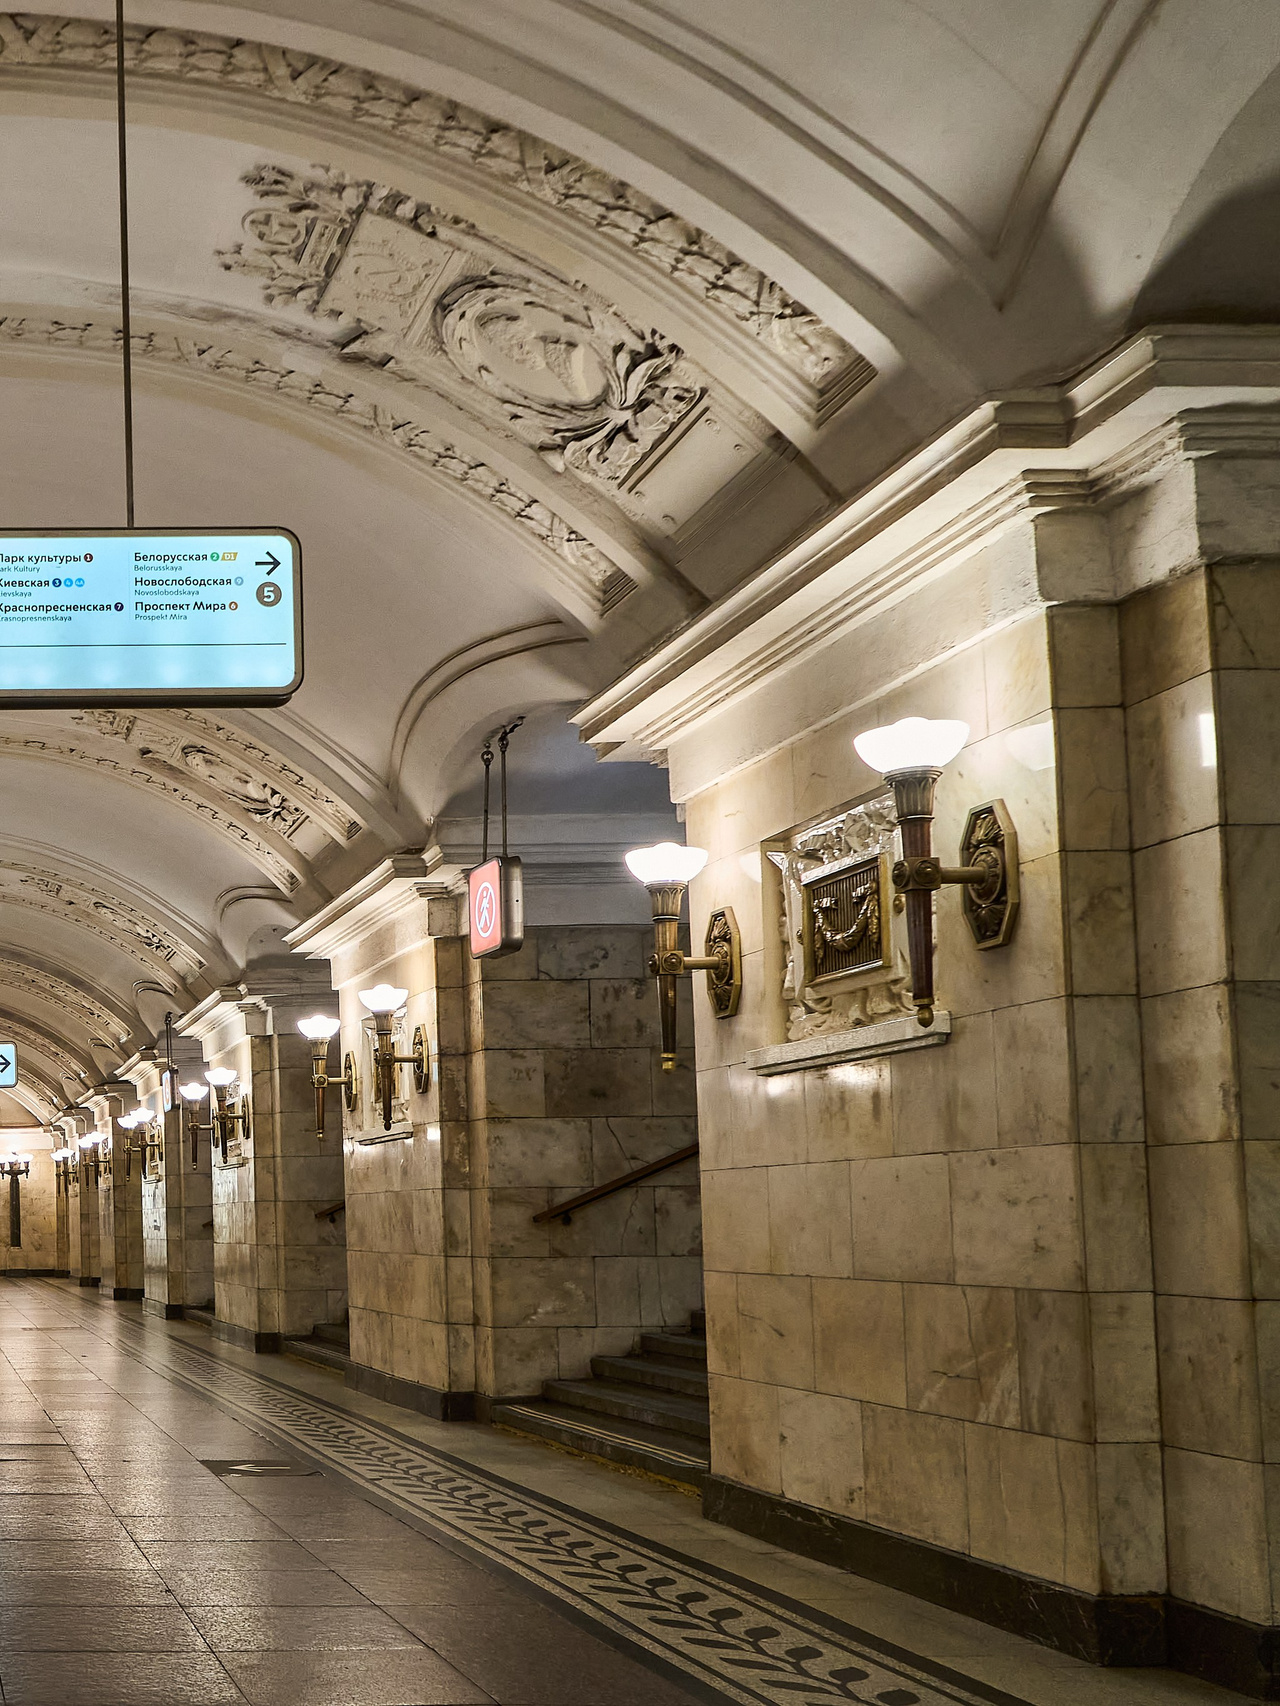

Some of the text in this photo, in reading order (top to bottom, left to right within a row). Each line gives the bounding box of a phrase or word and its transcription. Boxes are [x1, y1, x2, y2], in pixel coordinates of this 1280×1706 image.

[28, 553, 81, 564] культуры
[135, 553, 207, 563] Белорусская
[13, 565, 40, 573] Kultury
[135, 577, 231, 587] Новослободская
[263, 587, 275, 602] 5
[135, 602, 190, 613] Проспект
[193, 602, 225, 613] Мира
